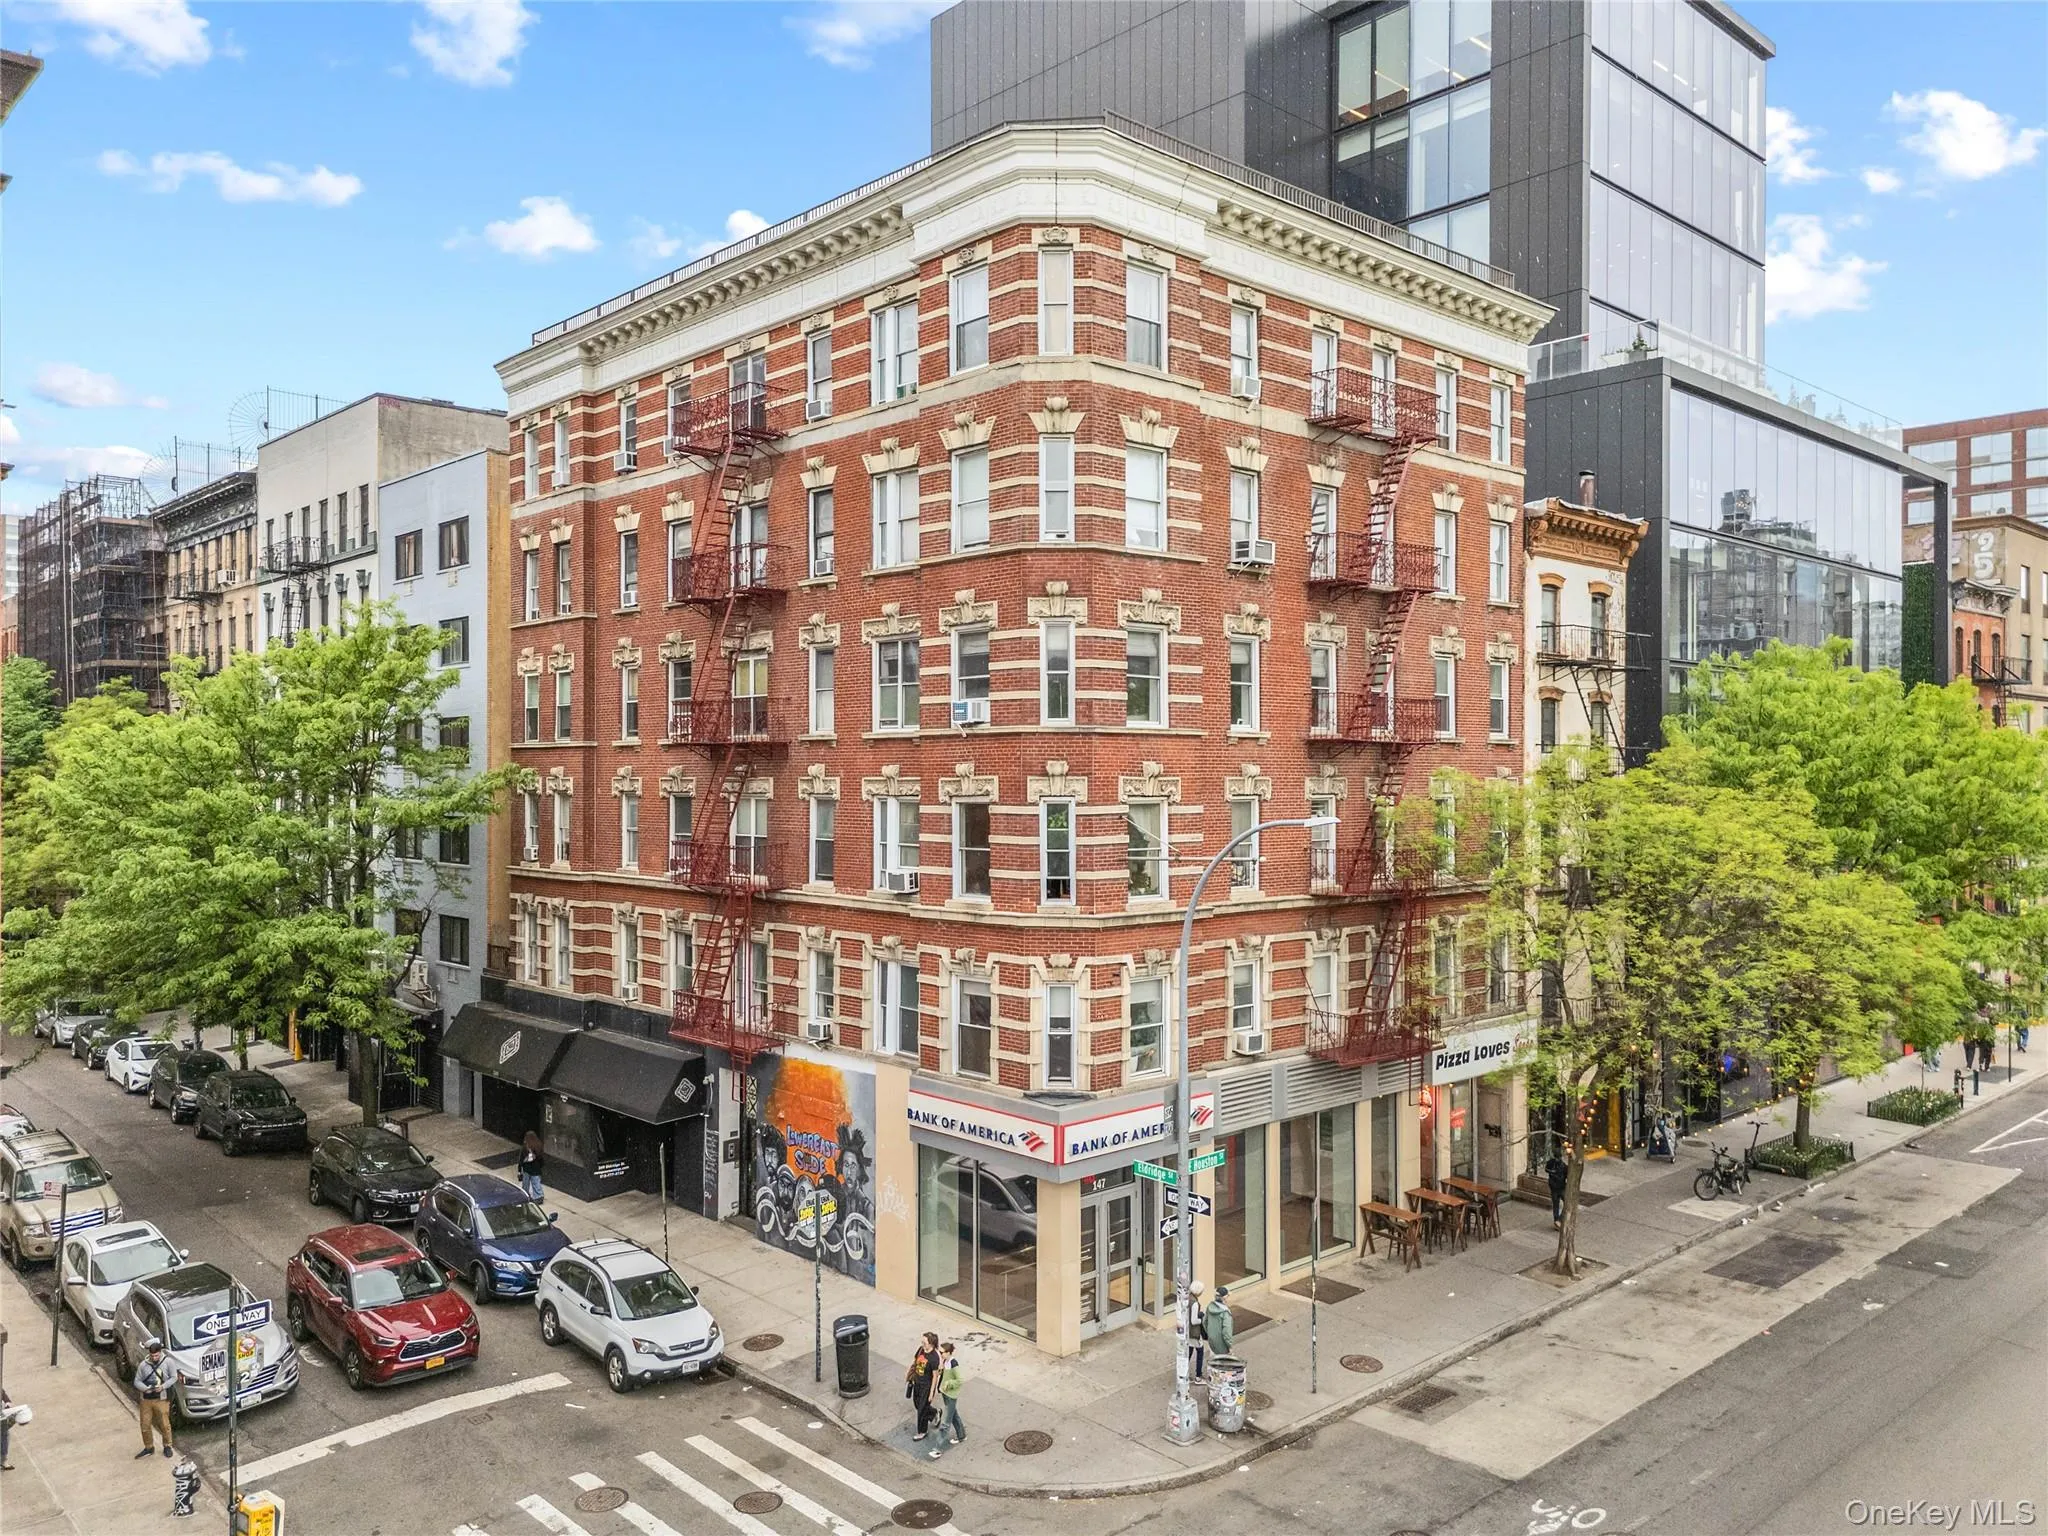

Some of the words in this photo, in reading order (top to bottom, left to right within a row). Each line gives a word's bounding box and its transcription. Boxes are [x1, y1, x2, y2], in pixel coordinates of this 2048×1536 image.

[1436, 1049, 1470, 1070] Pizza
[1474, 1041, 1510, 1061] Loves
[907, 1108, 938, 1126] BANK
[941, 1117, 956, 1129] OF
[959, 1121, 1015, 1146] AMERICA
[1072, 1136, 1108, 1155] BANK
[1112, 1131, 1128, 1145] OF
[1132, 1123, 1165, 1141] AMER
[1137, 1163, 1166, 1182] Eldridge
[1194, 1154, 1218, 1170] Houston
[1092, 1177, 1106, 1191] 147
[206, 1318, 228, 1331] ONE
[242, 1310, 262, 1322] WAY
